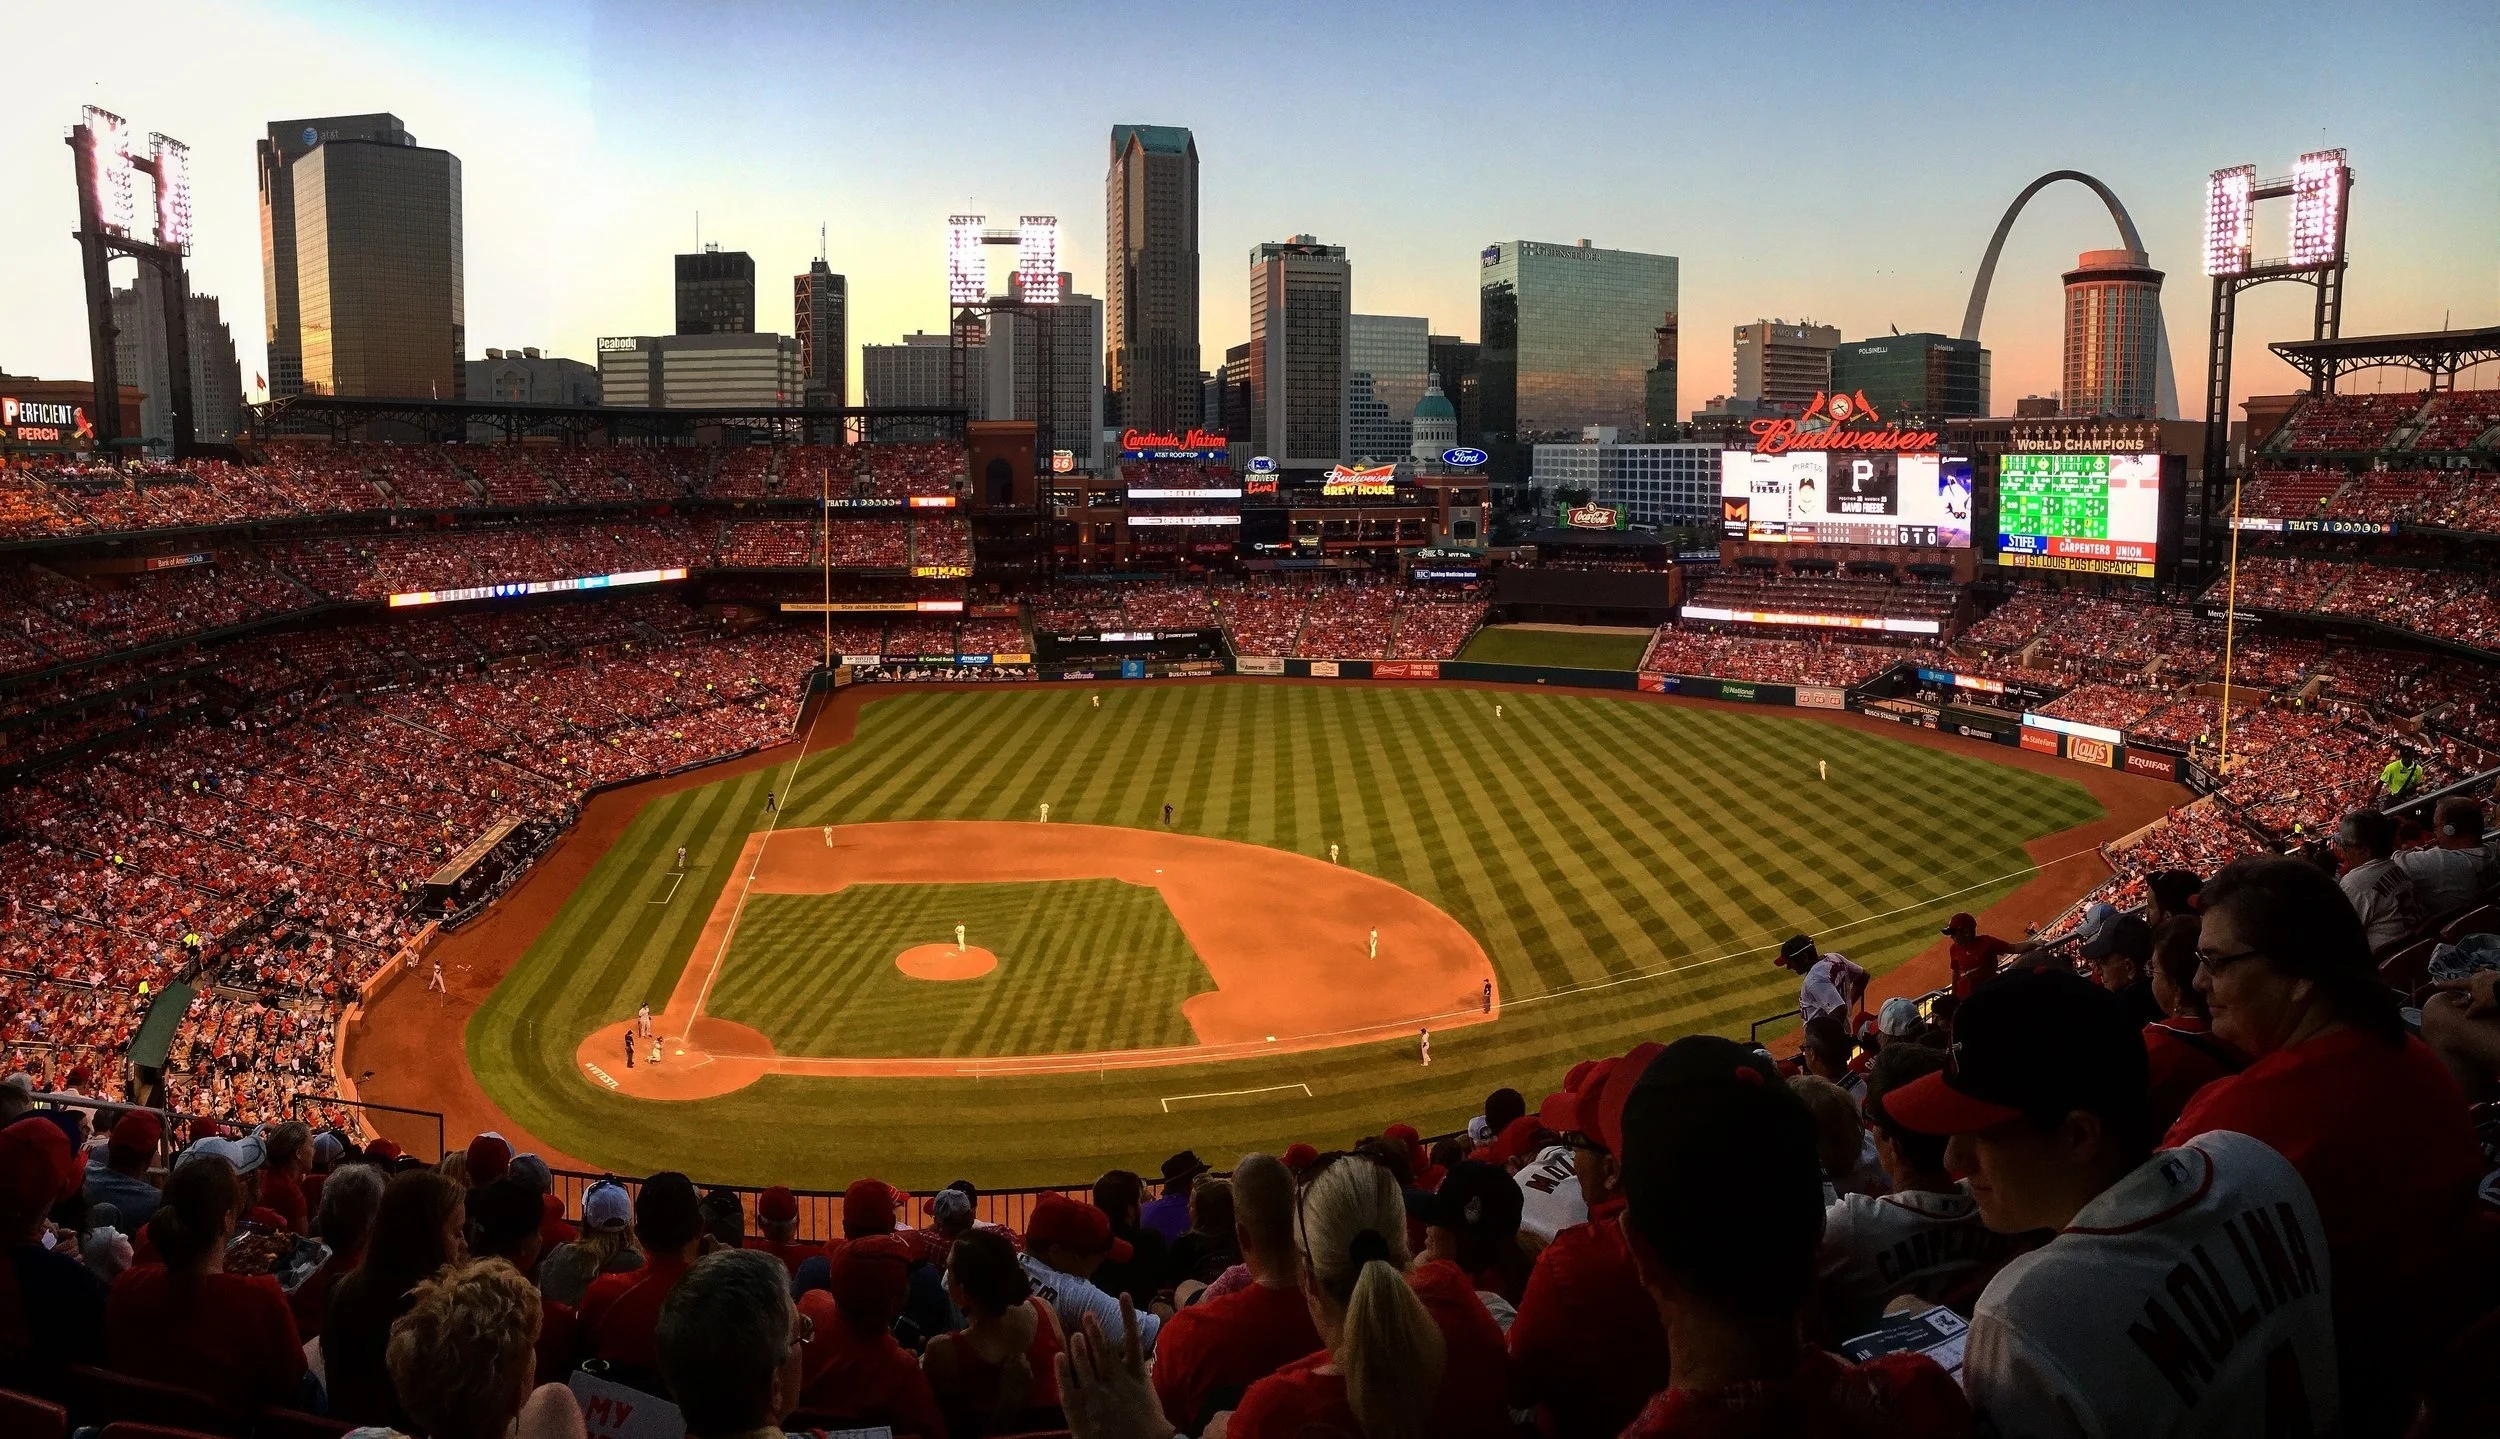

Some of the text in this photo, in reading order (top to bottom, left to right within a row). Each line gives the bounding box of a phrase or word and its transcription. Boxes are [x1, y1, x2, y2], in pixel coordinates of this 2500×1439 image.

[1482, 255, 1498, 267] KPMG
[598, 337, 637, 351] Peabody
[1858, 346, 1888, 355] POLSINELLI
[2, 397, 72, 426] PERFICIENT
[17, 427, 59, 441] PERCH
[1122, 429, 1226, 450] Cardinals Nation
[1749, 418, 1938, 453] Budweiser
[2016, 439, 2145, 451] WORLD CHAMPIONS
[1451, 449, 1479, 463] Ford
[1053, 458, 1070, 469] 66
[1253, 460, 1271, 469] FOX
[1245, 473, 1279, 482] MIDWEST
[1323, 471, 1395, 485] Budweiser
[1852, 460, 1874, 492] P
[1246, 482, 1278, 494] Live!
[1323, 485, 1395, 496] BREW HOUSE
[852, 498, 858, 507] A
[1841, 502, 1862, 513] DAVID
[1574, 510, 1612, 524] Coca-Cola
[2288, 520, 2318, 532] THAT'S
[2323, 521, 2329, 532] A
[2333, 522, 2381, 534] POWER
[1900, 532, 1909, 544] 0
[1913, 532, 1920, 544] 1
[1927, 533, 1936, 545] 0
[2008, 535, 2037, 548] STIFEL
[2059, 541, 2142, 557] CARPENTERS UNION
[176, 556, 193, 565] America
[194, 554, 203, 562] Club
[2029, 555, 2041, 567] ST.
[2042, 557, 2066, 569] LOUIS
[2069, 559, 2138, 575] POST-DISPATCH
[917, 566, 967, 577] BIG MAC
[2207, 609, 2226, 619] Mercy
[1063, 671, 1095, 680] Scottrade
[1659, 675, 1680, 683] America
[1730, 686, 1755, 695] National
[2004, 686, 2017, 696] Mercy
[1864, 708, 1901, 722] BUSCH STADIUM
[1970, 728, 1992, 739] MIDWEST
[2127, 755, 2170, 773] EQUIFAX
[2127, 1202, 2320, 1408] MOLINA
[585, 1394, 634, 1428] MY
